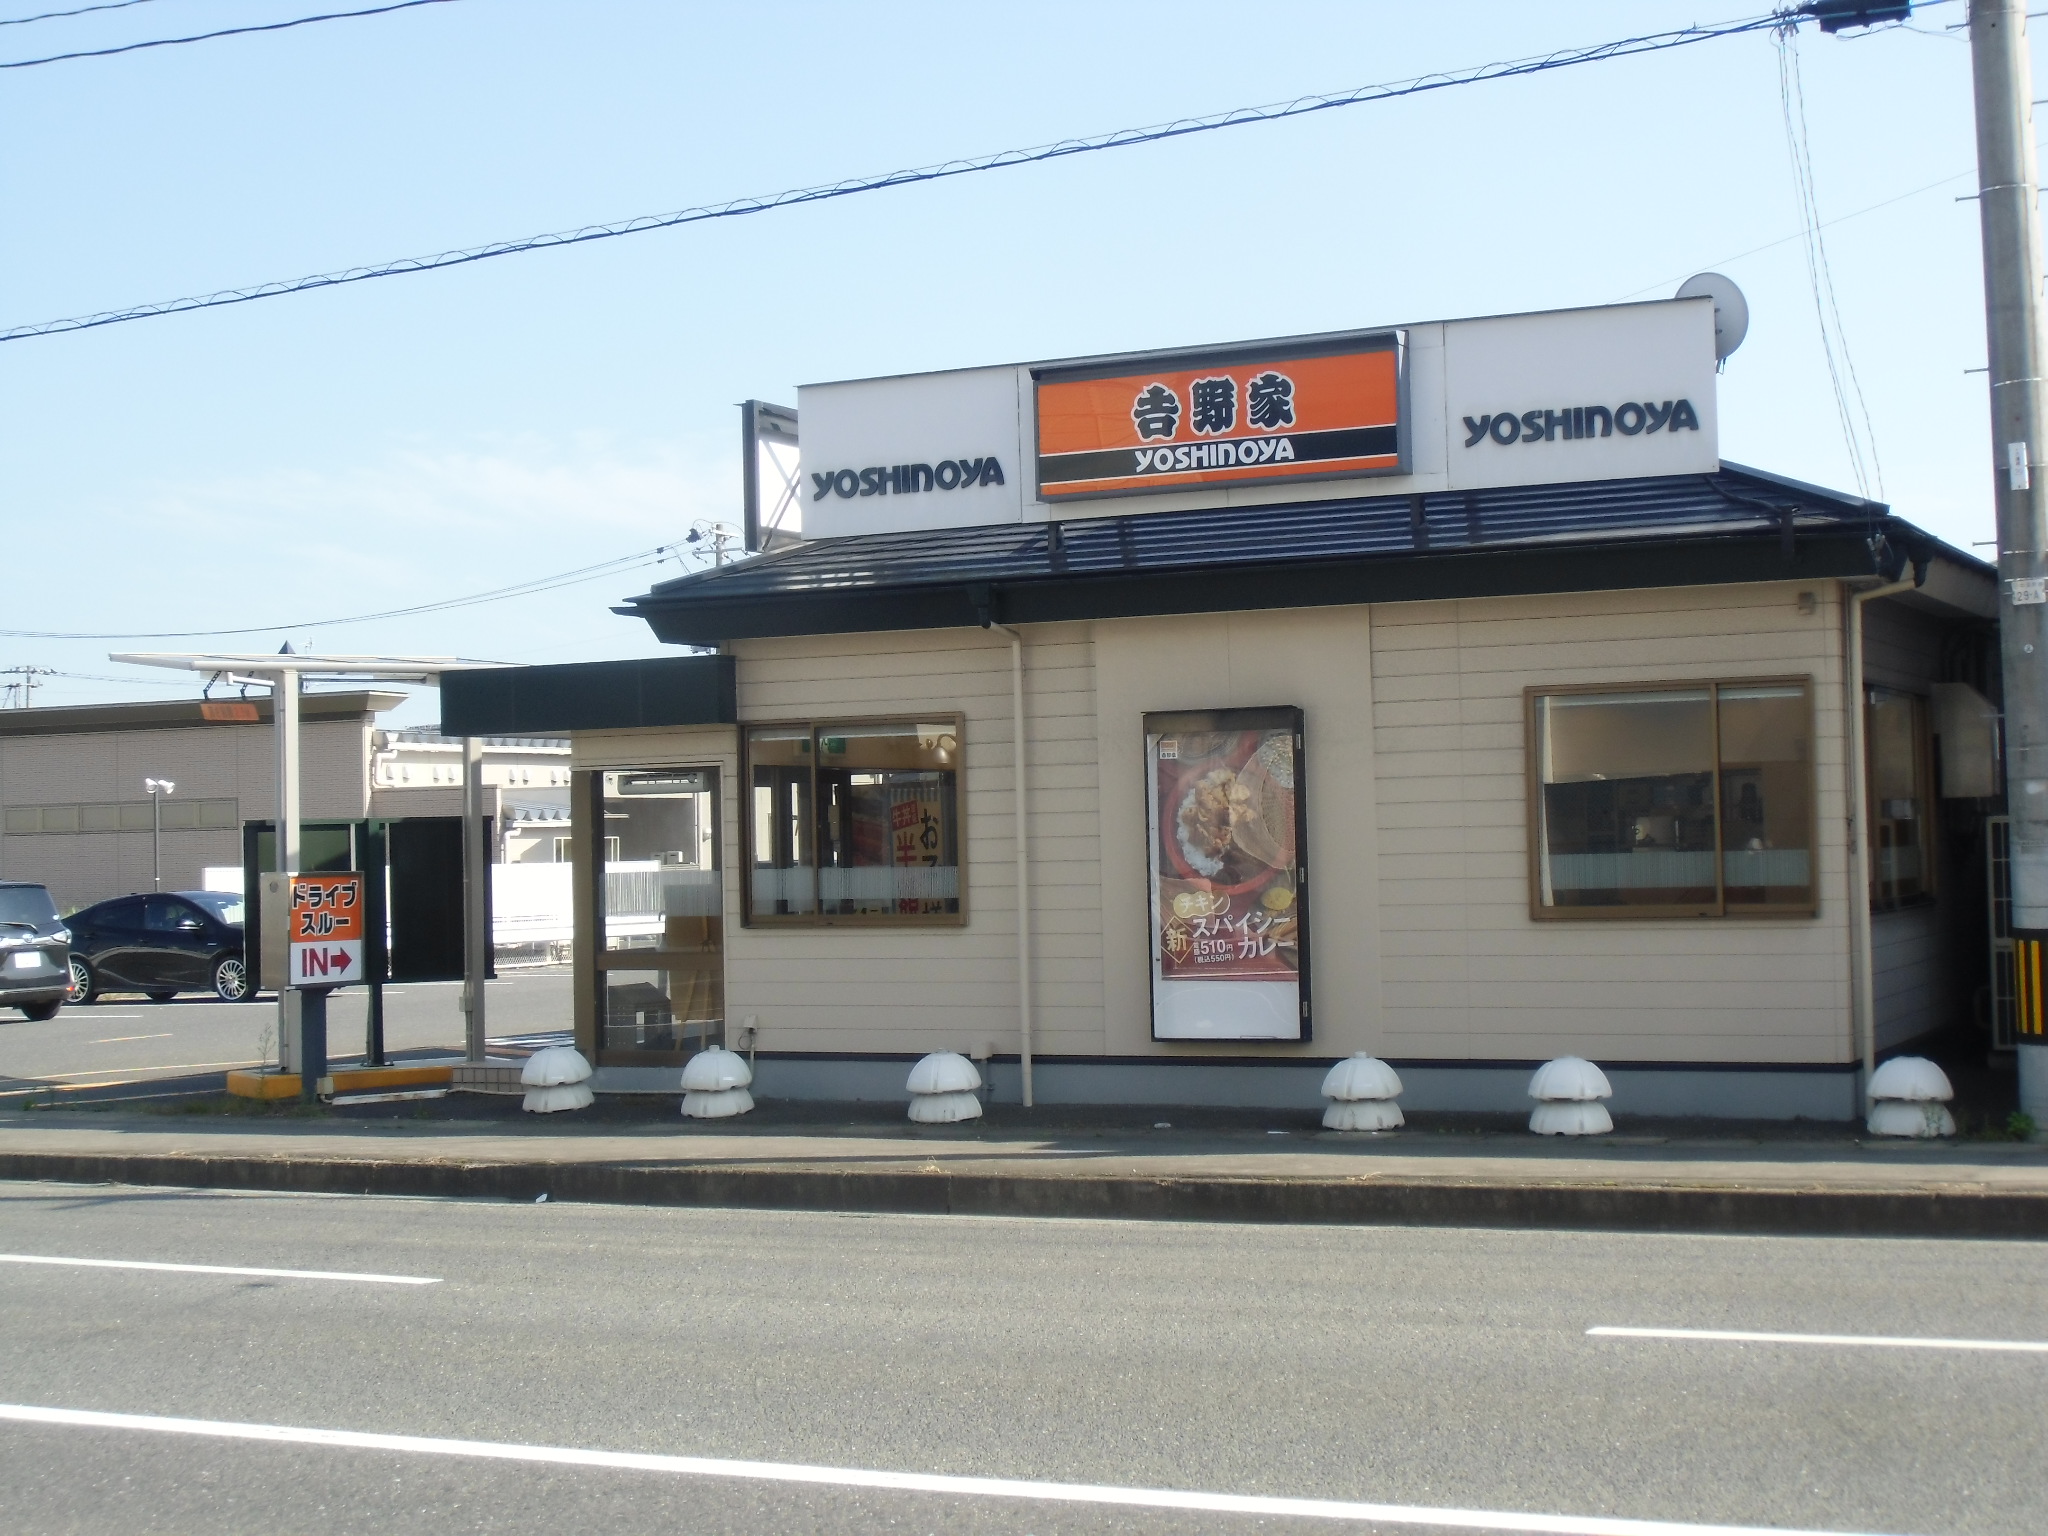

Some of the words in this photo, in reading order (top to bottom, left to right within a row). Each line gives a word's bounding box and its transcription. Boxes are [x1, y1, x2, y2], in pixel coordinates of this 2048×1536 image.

[1464, 399, 1698, 448] YOSHINOYA
[1134, 438, 1295, 473] YOSHINOYA
[812, 456, 1004, 500] YOSHINOYA
[292, 880, 358, 909] ドライブ
[1178, 895, 1224, 914] チキン
[300, 911, 351, 936] スルー
[1192, 911, 1291, 938] スパイシー
[1165, 926, 1187, 952] 新
[1237, 937, 1295, 959] カレー
[302, 948, 328, 977] IN
